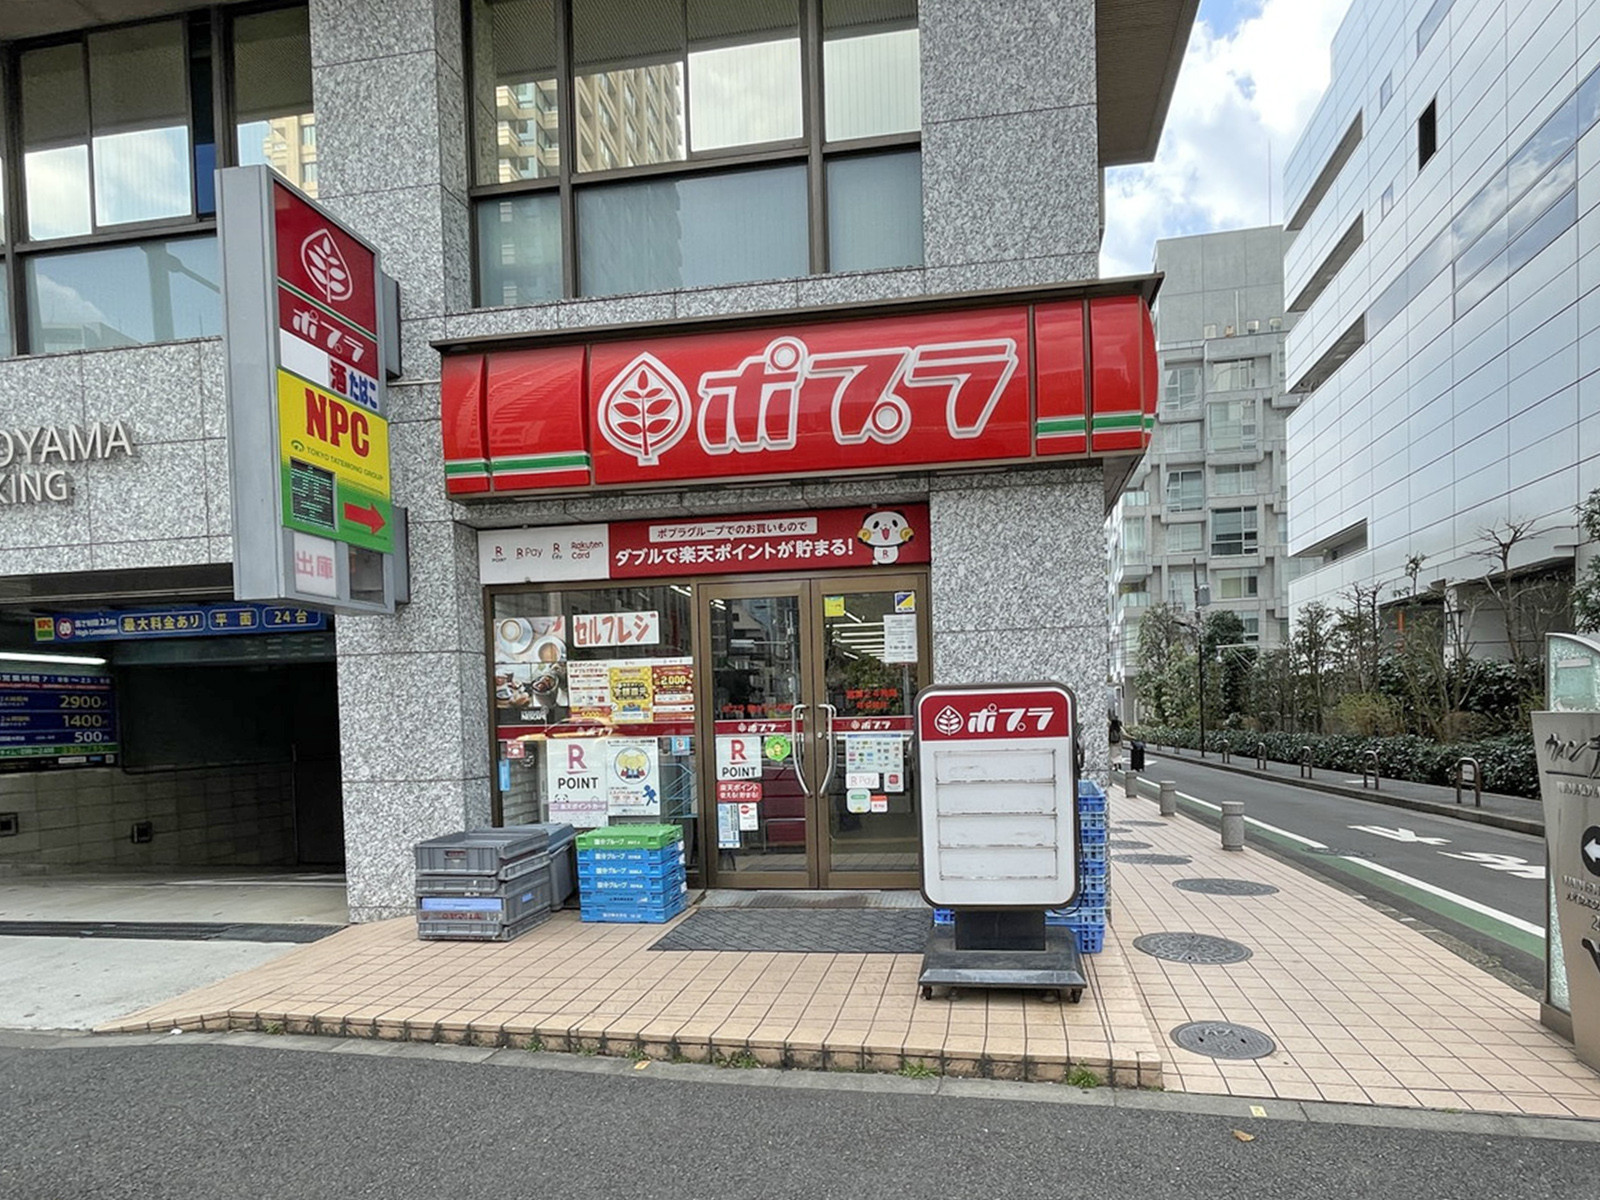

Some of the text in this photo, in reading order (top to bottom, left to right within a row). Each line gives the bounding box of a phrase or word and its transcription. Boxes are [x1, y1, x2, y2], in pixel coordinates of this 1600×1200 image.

[292, 308, 364, 363] ポプラ
[330, 358, 377, 409] 酒 たばこ
[698, 335, 1018, 455] ポプラ
[305, 387, 370, 458] NPC
[307, 446, 329, 461] TOKYO
[363, 469, 383, 480] GROUP
[656, 521, 808, 539] ポプラグループでのお買いもので
[525, 547, 543, 558] Pay
[571, 541, 604, 549] Rakuten
[571, 551, 590, 560] Card
[615, 538, 854, 566] ダブルで楽天ポイントが貯まる!
[296, 551, 333, 579] 出庫
[123, 614, 200, 631] 最大料金あり
[574, 613, 656, 645] セルフレジ
[967, 703, 1055, 733] ポプラ
[557, 777, 599, 790] POINT
[722, 766, 757, 778] POINT
